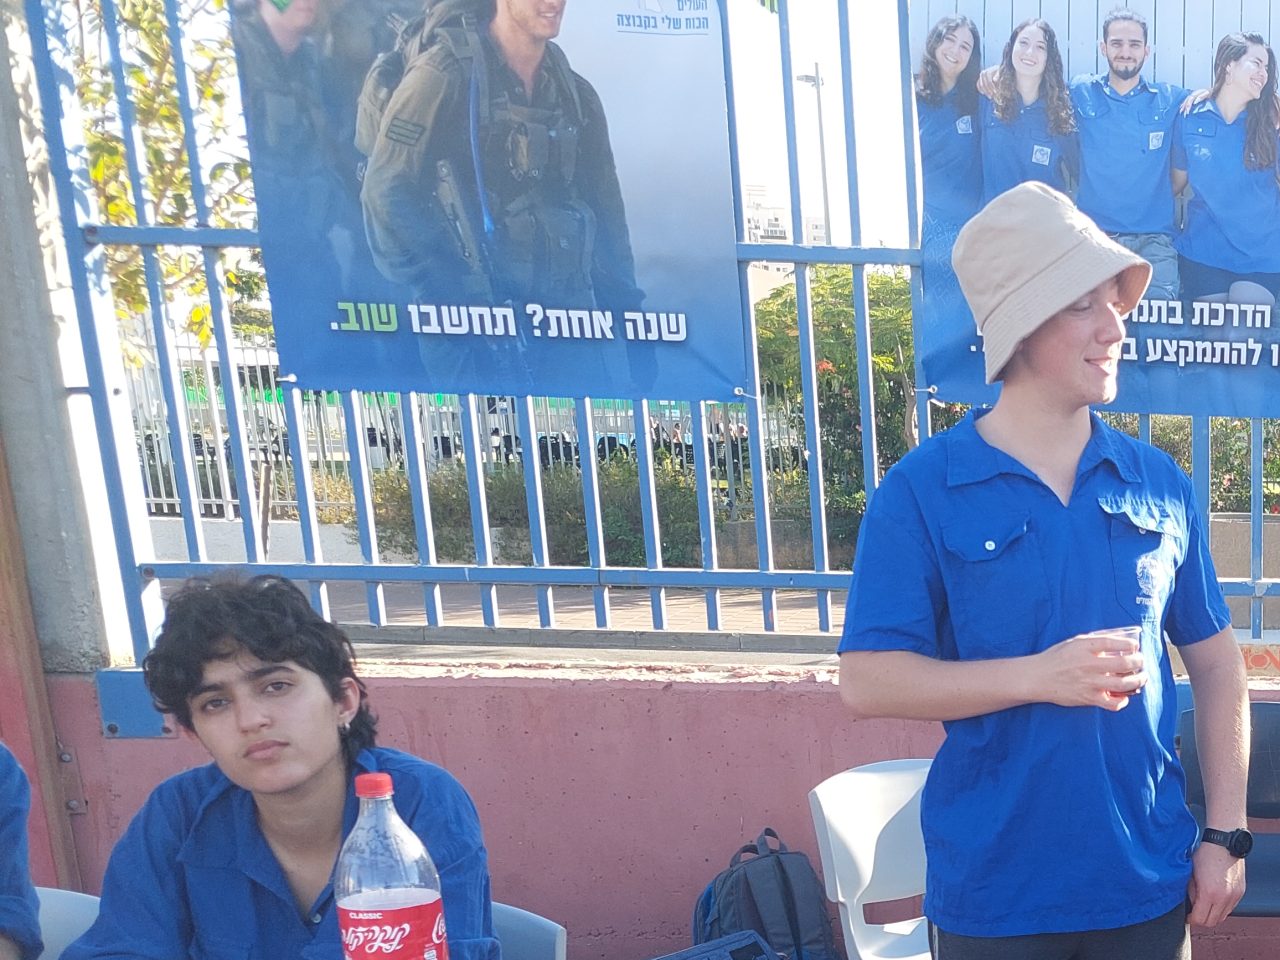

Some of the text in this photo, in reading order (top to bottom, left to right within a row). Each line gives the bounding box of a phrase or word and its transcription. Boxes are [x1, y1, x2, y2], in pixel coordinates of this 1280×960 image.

[616, 13, 709, 30] הכוח שלי בקבוצה
[330, 301, 687, 341] שנה אחת? תחשבו שוב.
[1120, 299, 1272, 328] הדרכת בתנו
[1146, 338, 1263, 367] להתמקצע
